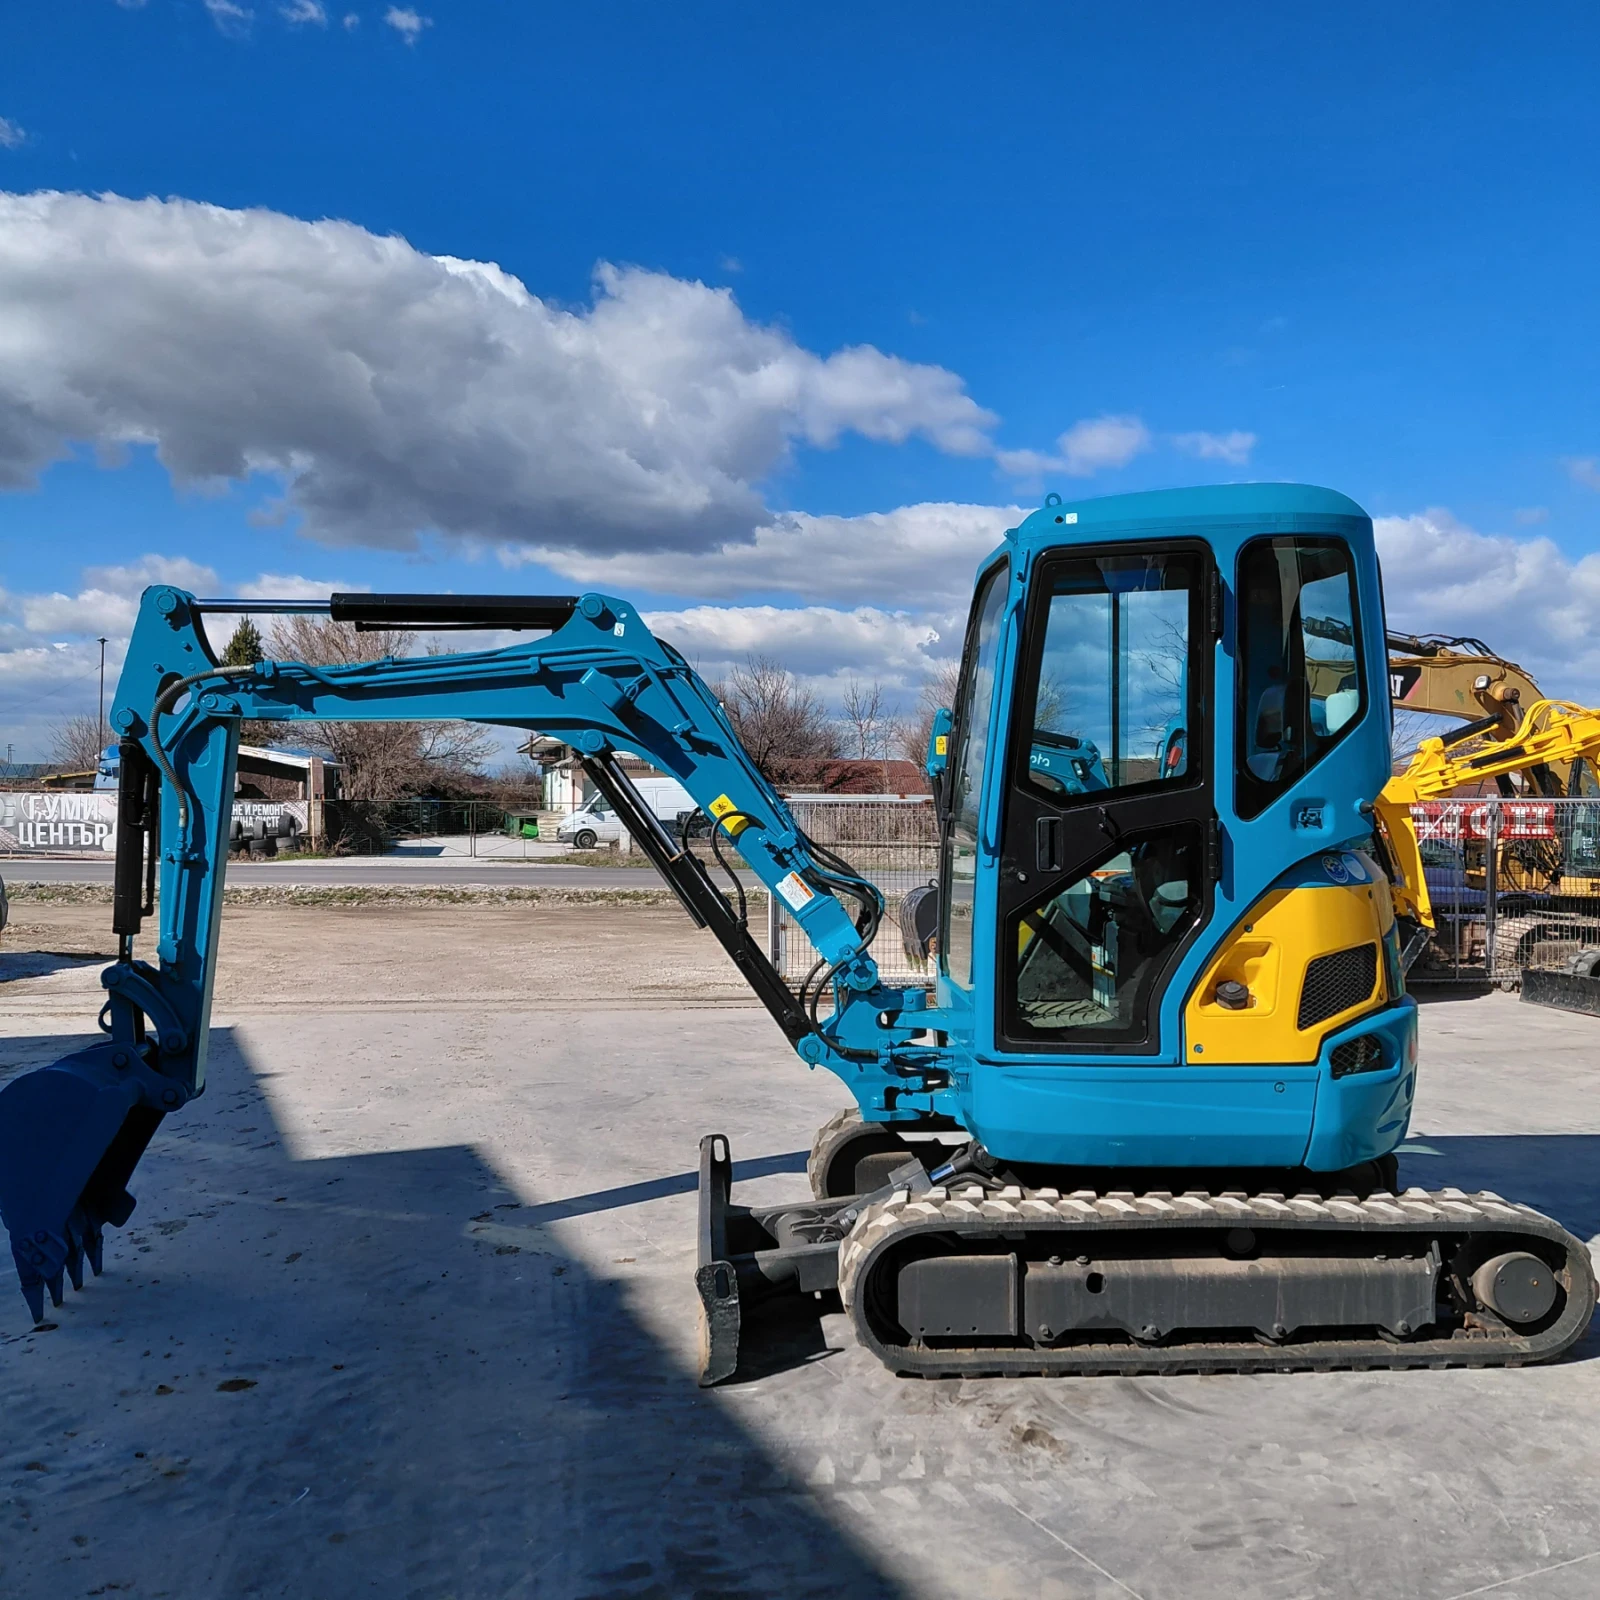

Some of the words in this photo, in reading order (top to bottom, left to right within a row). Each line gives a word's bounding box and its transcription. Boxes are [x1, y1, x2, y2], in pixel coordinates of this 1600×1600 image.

[1029, 753, 1050, 767] ota
[29, 794, 99, 820] ГУМИ
[252, 804, 284, 816] РЕМОНТ
[18, 822, 108, 848] ЦЕНТЪР
